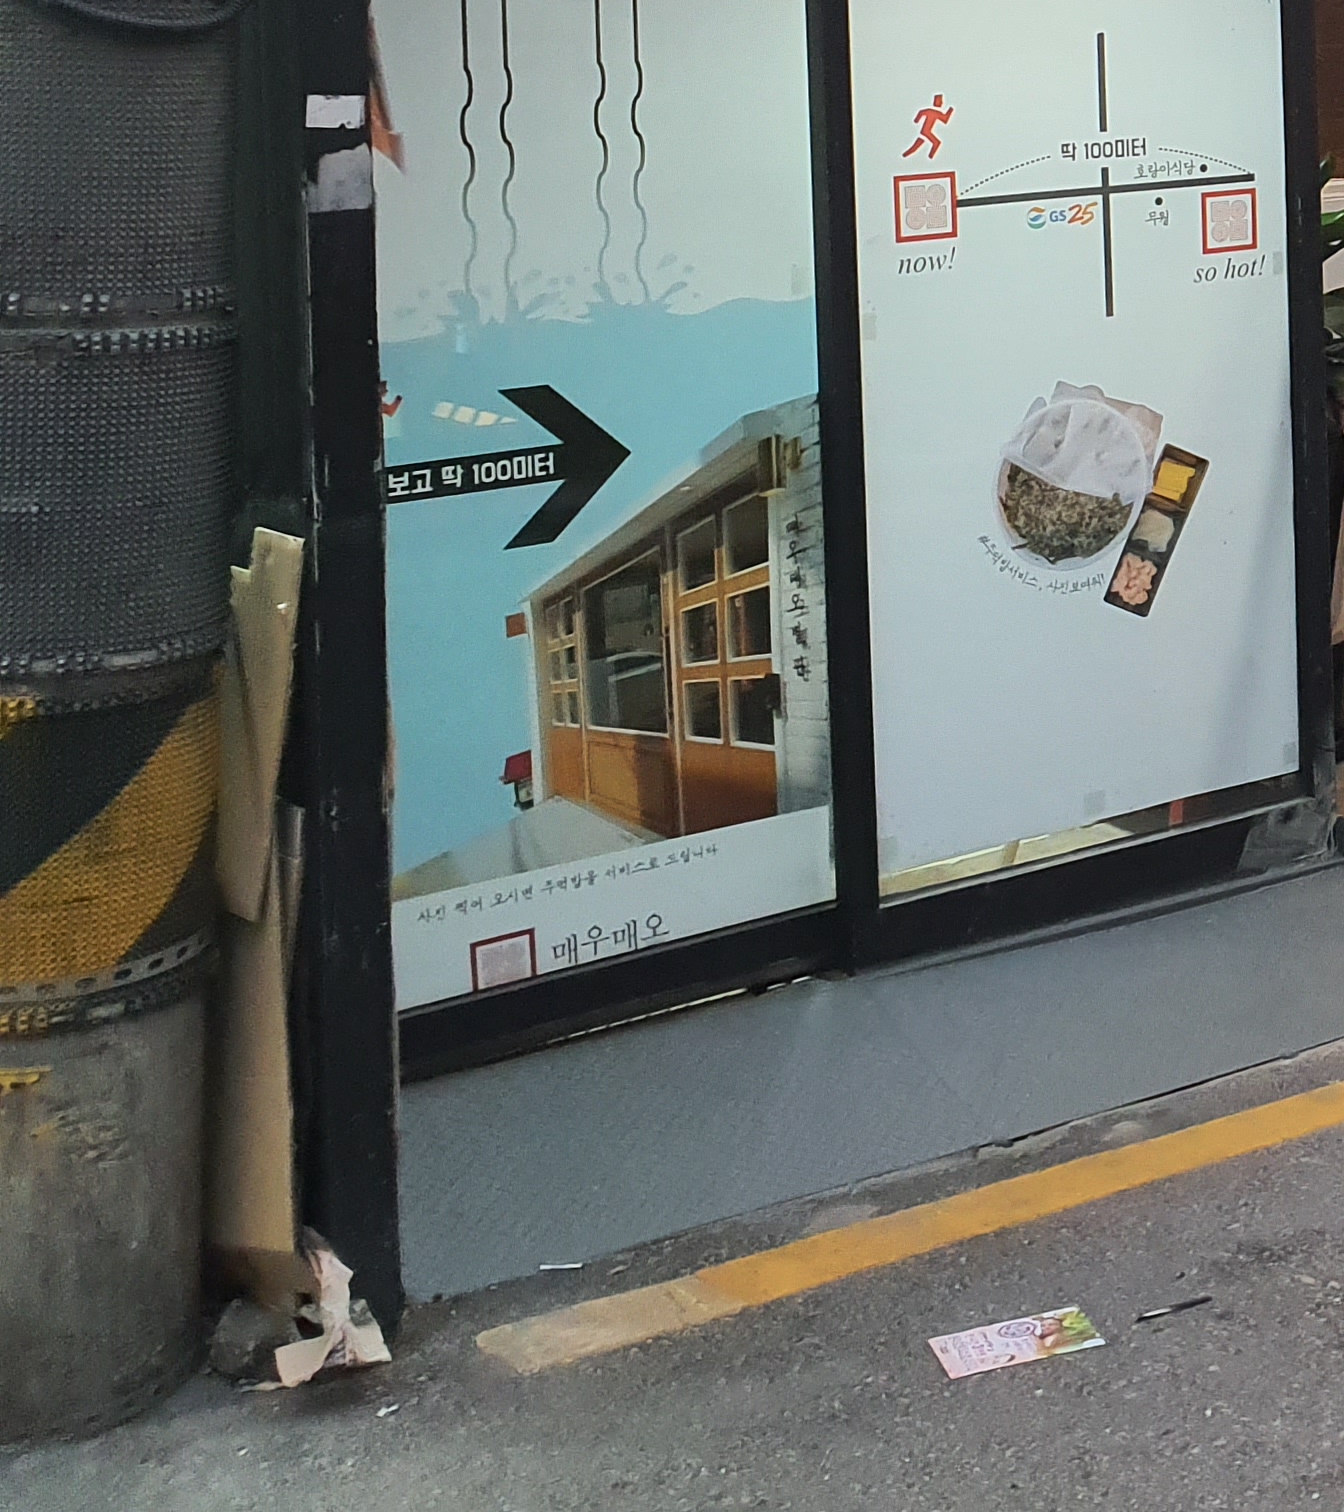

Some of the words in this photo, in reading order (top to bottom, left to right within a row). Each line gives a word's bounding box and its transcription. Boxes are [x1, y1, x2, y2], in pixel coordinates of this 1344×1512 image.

[1061, 141, 1077, 161] 딱
[1084, 138, 1148, 161] 100미터
[897, 247, 957, 276] now!
[1193, 264, 1218, 284] so
[1223, 254, 1267, 281] hot!
[442, 464, 464, 489] 딱
[473, 451, 556, 486] 100미터
[551, 913, 670, 966] 매우매오
